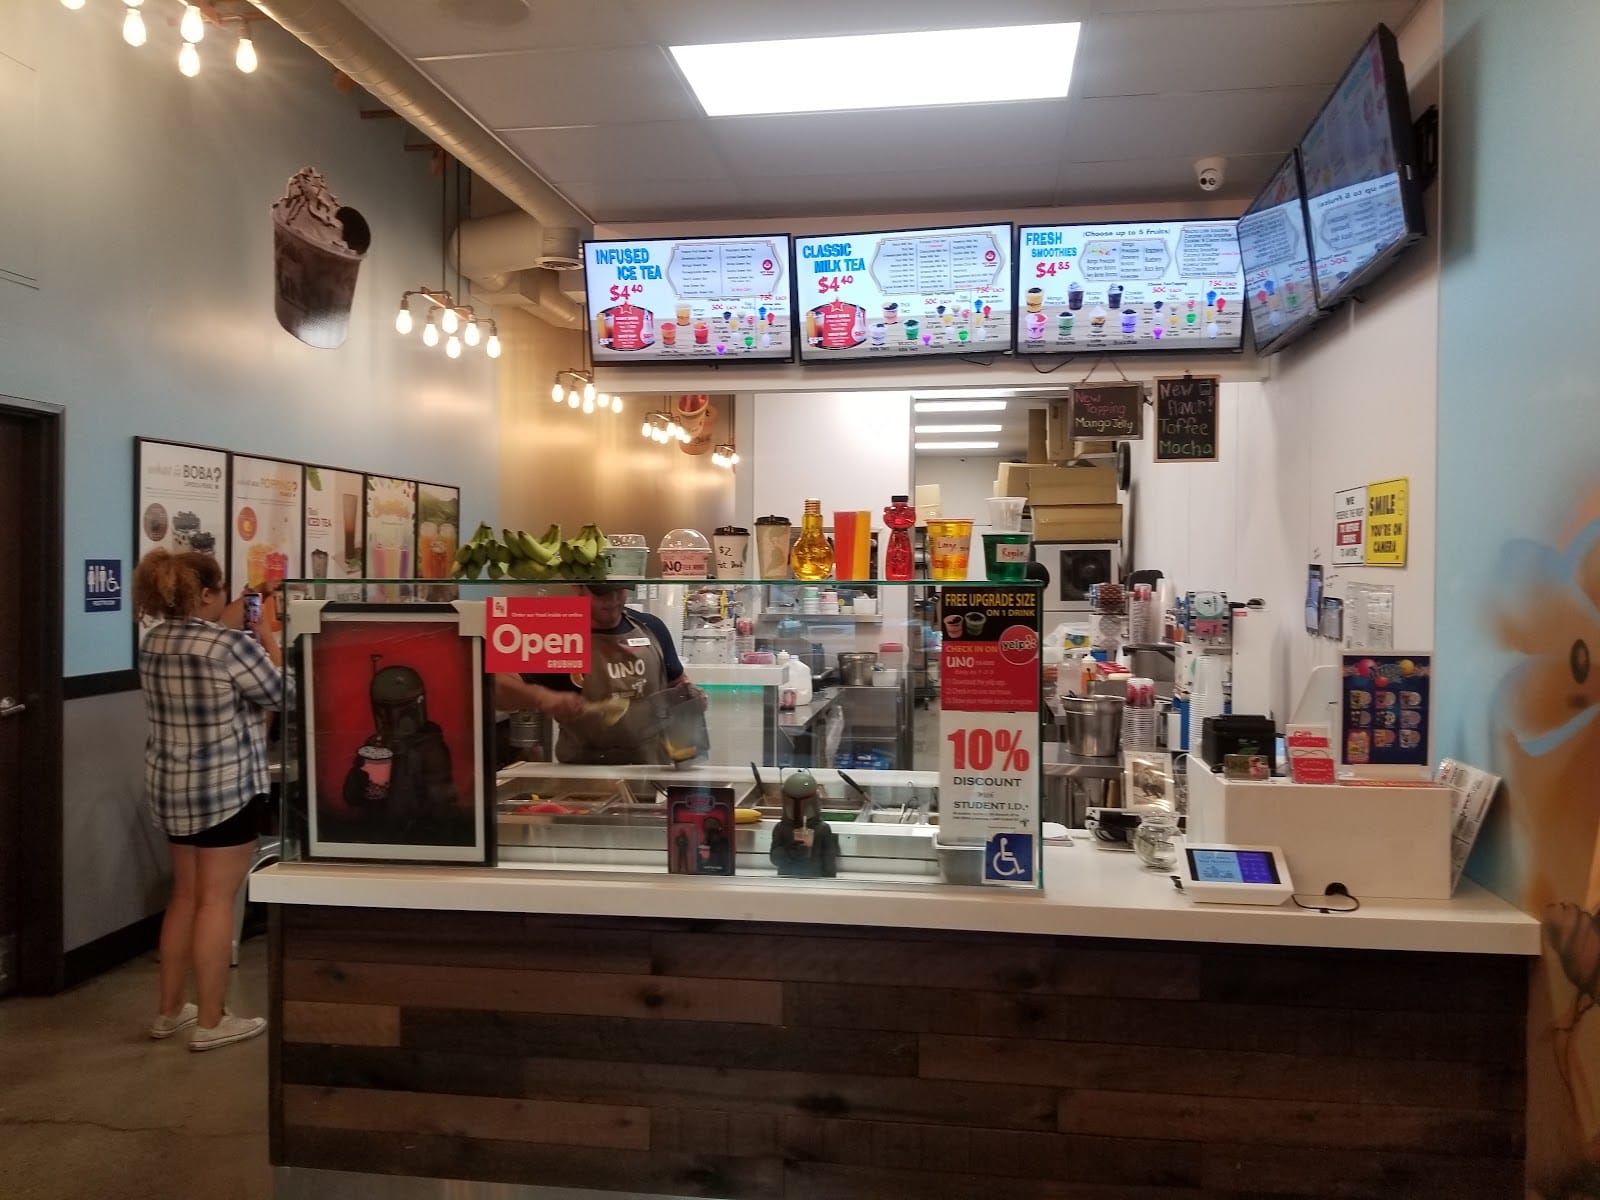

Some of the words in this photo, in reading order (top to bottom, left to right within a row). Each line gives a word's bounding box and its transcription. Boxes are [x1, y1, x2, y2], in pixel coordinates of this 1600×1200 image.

[1026, 232, 1062, 246] FRESH
[596, 248, 649, 264] INFUSED
[803, 243, 852, 259] CLASSIC
[1032, 248, 1077, 258] SMOOTHIES
[617, 266, 637, 281] ICE
[640, 265, 662, 280] TEA
[814, 260, 841, 274] MILK
[844, 258, 865, 272] TEA
[1160, 384, 1193, 399] New
[1076, 417, 1111, 432] Mango
[1160, 417, 1209, 436] Toffee
[1160, 440, 1213, 455] Mocha
[184, 464, 222, 483] BOBA?
[1369, 494, 1396, 517] SMILE
[1373, 540, 1396, 554] CAMERA
[945, 594, 968, 607] FREE
[969, 594, 1015, 607] UPGRADE
[1016, 594, 1036, 607] SIZE
[492, 624, 584, 661] Open
[1002, 639, 1025, 652] yelp
[608, 658, 646, 679] UNO
[946, 656, 975, 668] UNO
[947, 728, 1030, 772] 10%
[953, 776, 1022, 788] DISCOUNT
[953, 802, 1006, 811] STUDENT
